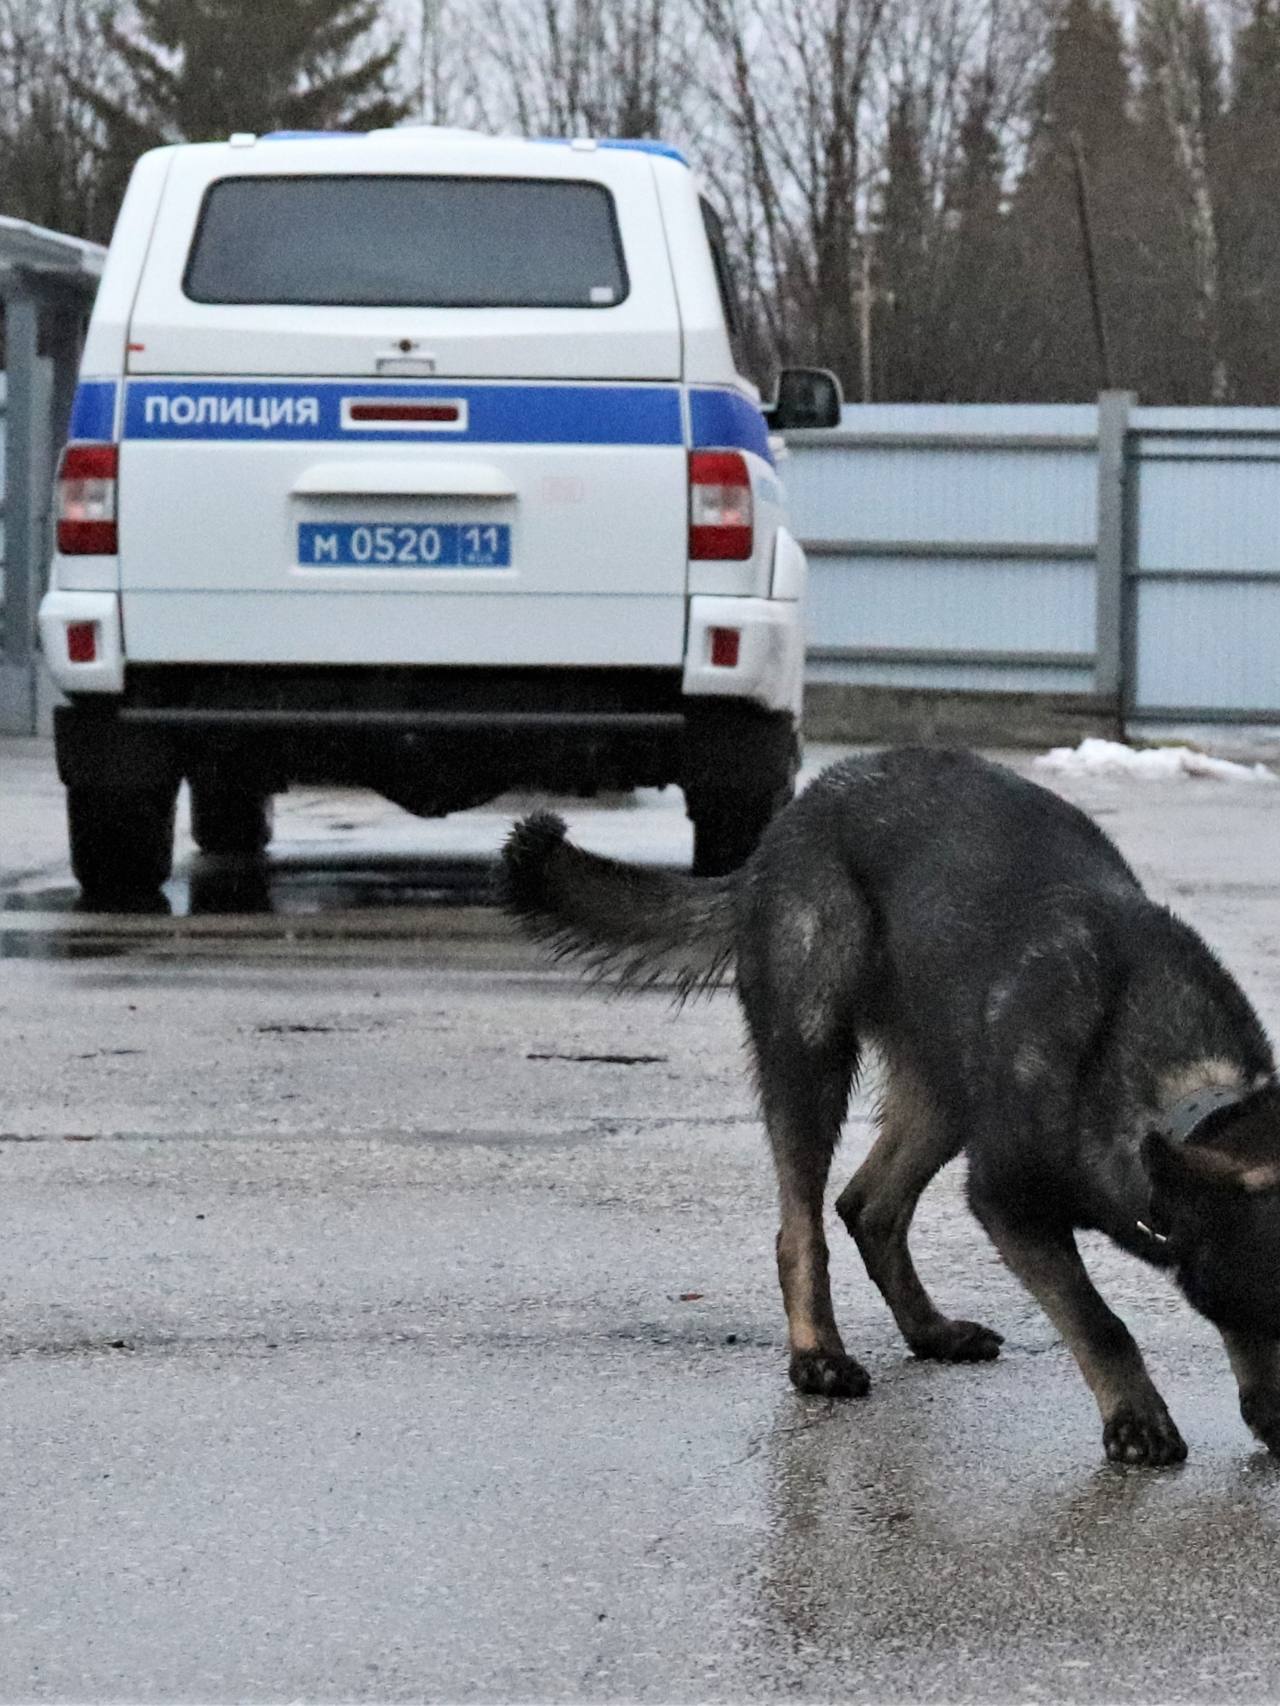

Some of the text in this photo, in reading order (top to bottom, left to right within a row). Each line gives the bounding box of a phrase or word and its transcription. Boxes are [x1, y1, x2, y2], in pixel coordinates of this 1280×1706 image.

[144, 395, 319, 429] ПОЛИЦИЯ
[351, 526, 441, 561] 0520
[464, 526, 498, 552] 11
